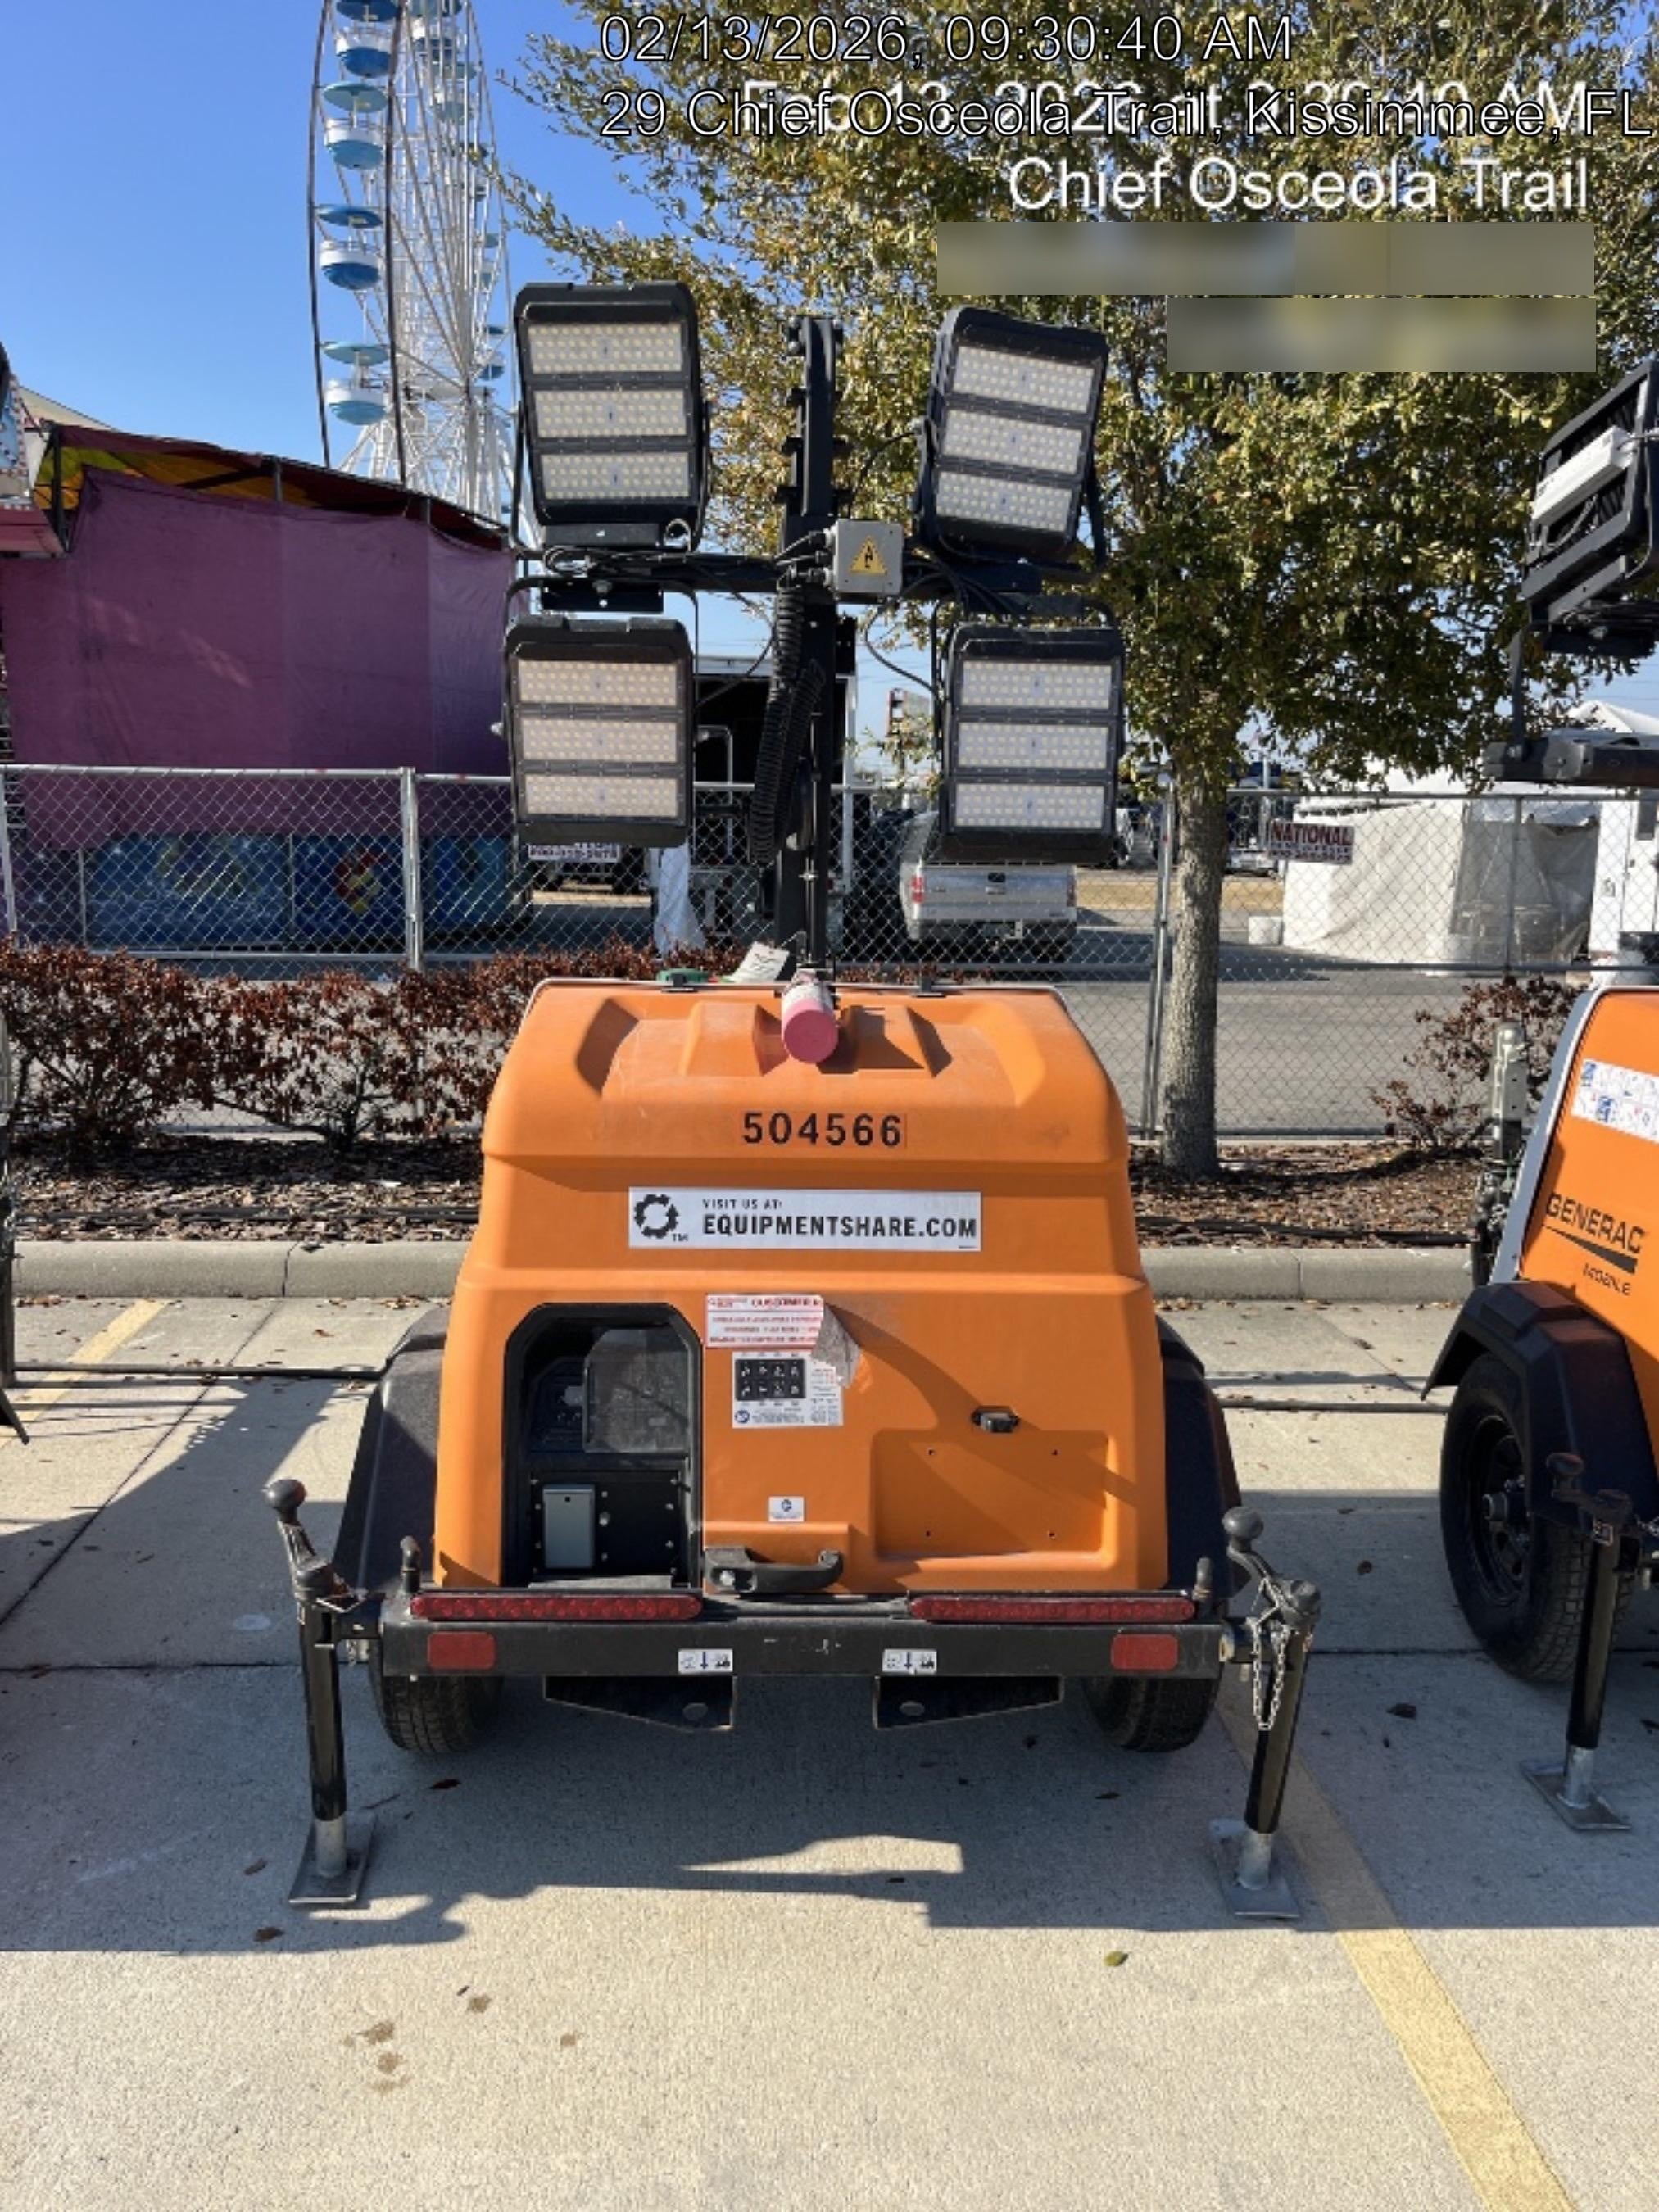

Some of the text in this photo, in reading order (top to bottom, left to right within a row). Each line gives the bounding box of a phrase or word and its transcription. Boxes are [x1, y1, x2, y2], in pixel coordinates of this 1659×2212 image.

[1271, 823, 1353, 845] NATIONAL
[742, 1112, 902, 1148] 504566
[702, 1198, 738, 1210] VISIT
[741, 1199, 759, 1210] US
[702, 1213, 977, 1239] EQUIPMENTSHARE.COM
[1546, 1192, 1646, 1254] GENERAC
